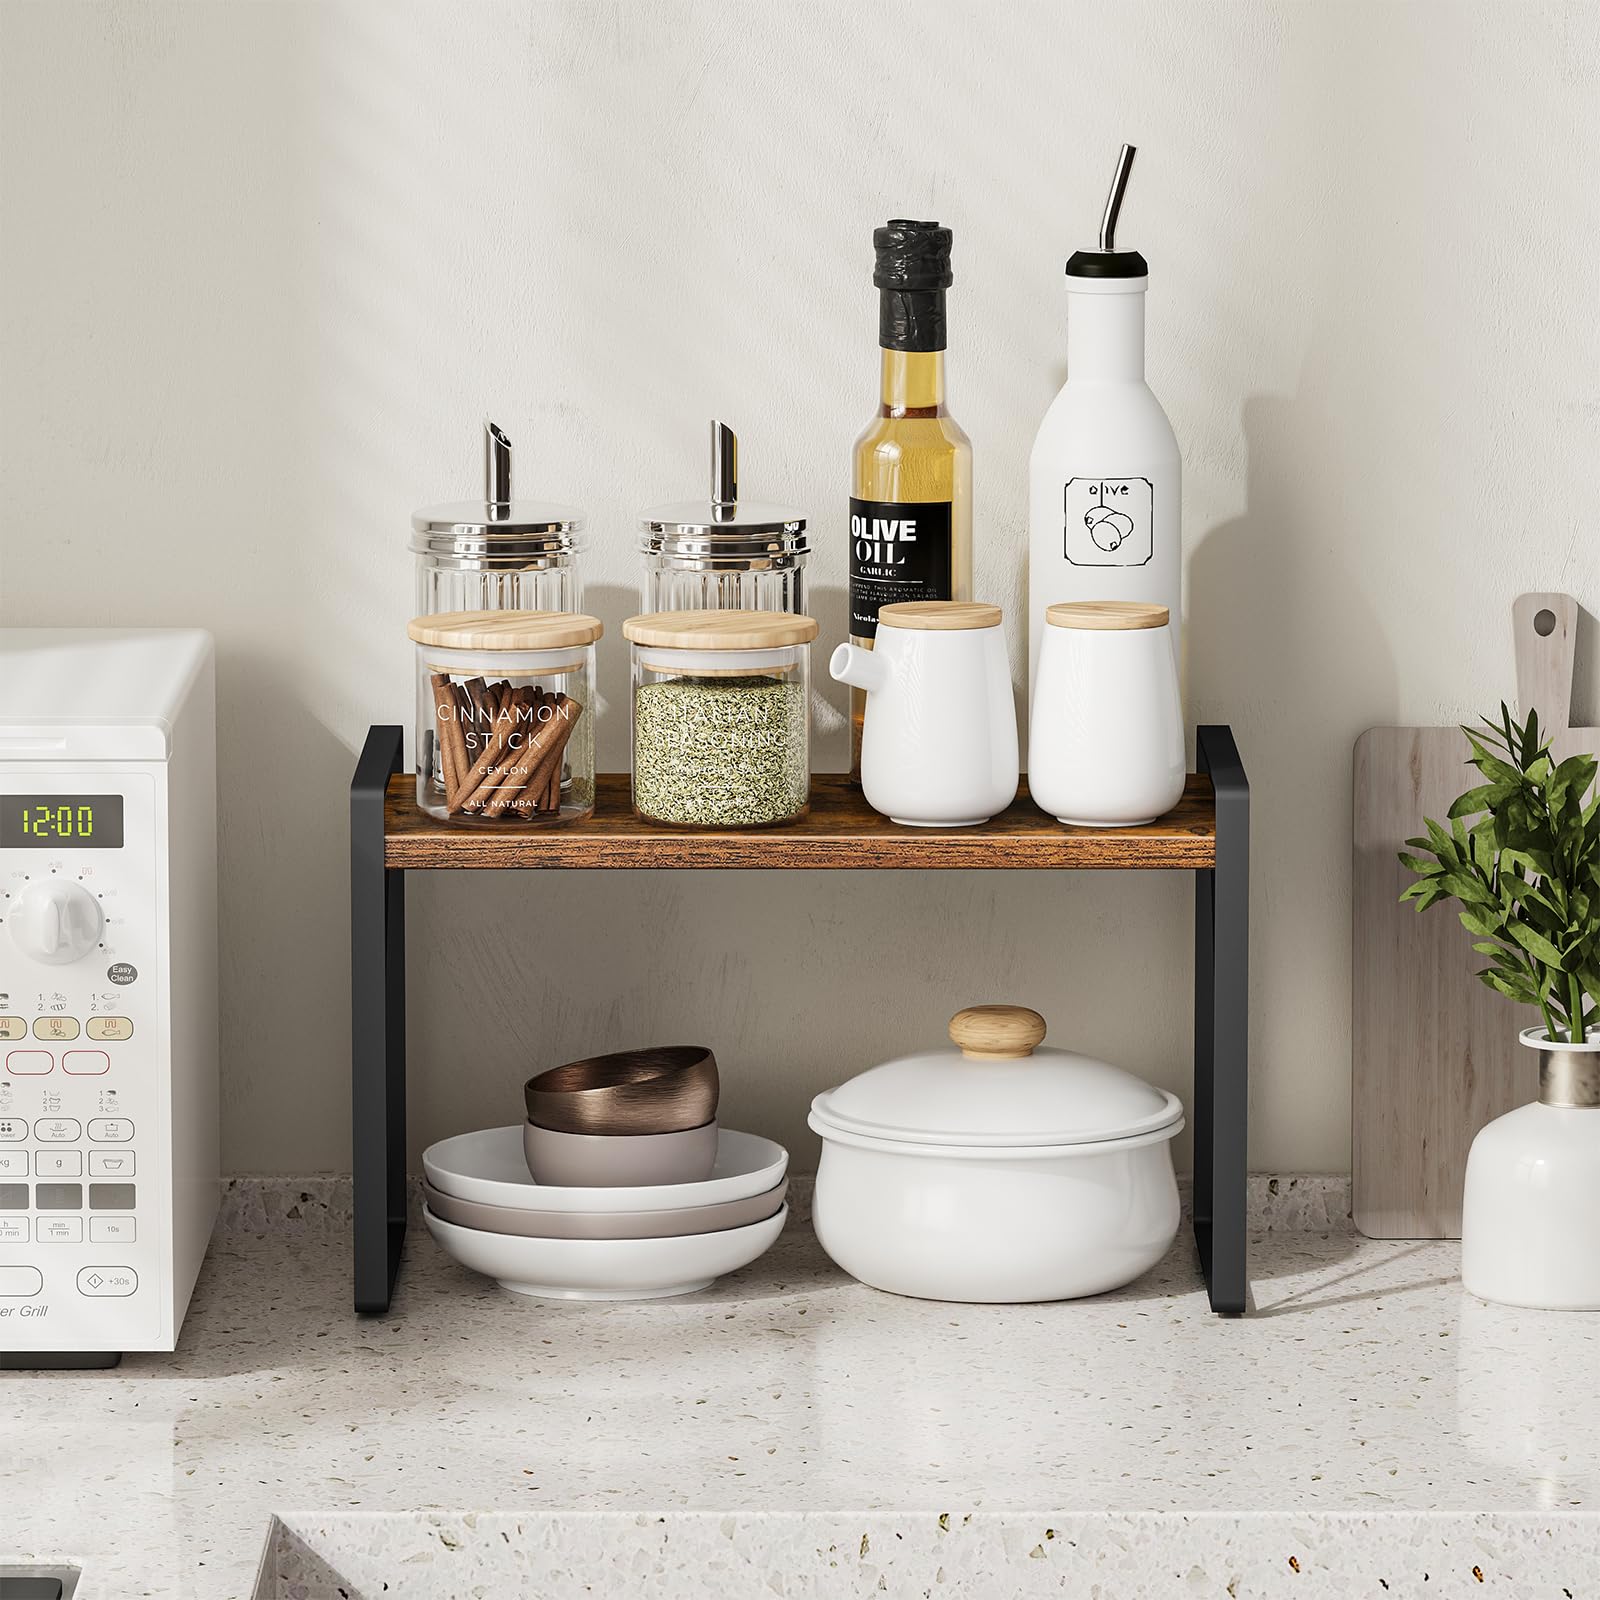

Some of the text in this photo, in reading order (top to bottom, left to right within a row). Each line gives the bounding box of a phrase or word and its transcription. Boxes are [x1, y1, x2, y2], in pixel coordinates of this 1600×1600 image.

[1089, 482, 1129, 496] olive
[851, 514, 917, 541] OLIVE
[855, 540, 905, 564] OIL
[860, 566, 897, 576] GARLIC
[437, 704, 569, 724] CINNAMON
[672, 705, 769, 723] ITALIAN
[465, 732, 542, 750] STICK
[655, 729, 786, 749] SEASONING
[478, 766, 528, 775] CEYLON
[469, 799, 538, 808] ALL NATURAL
[23, 806, 93, 837] 12:00
[112, 966, 132, 974] Easy
[110, 974, 134, 983] Clean
[38, 993, 46, 1001] 1.
[91, 993, 99, 1001] 1.
[37, 1003, 46, 1011] 2.
[90, 1003, 99, 1011] 2.
[56, 1159, 62, 1168] g
[109, 1277, 130, 1286] +30s
[0, 1305, 49, 1317] er Grill
